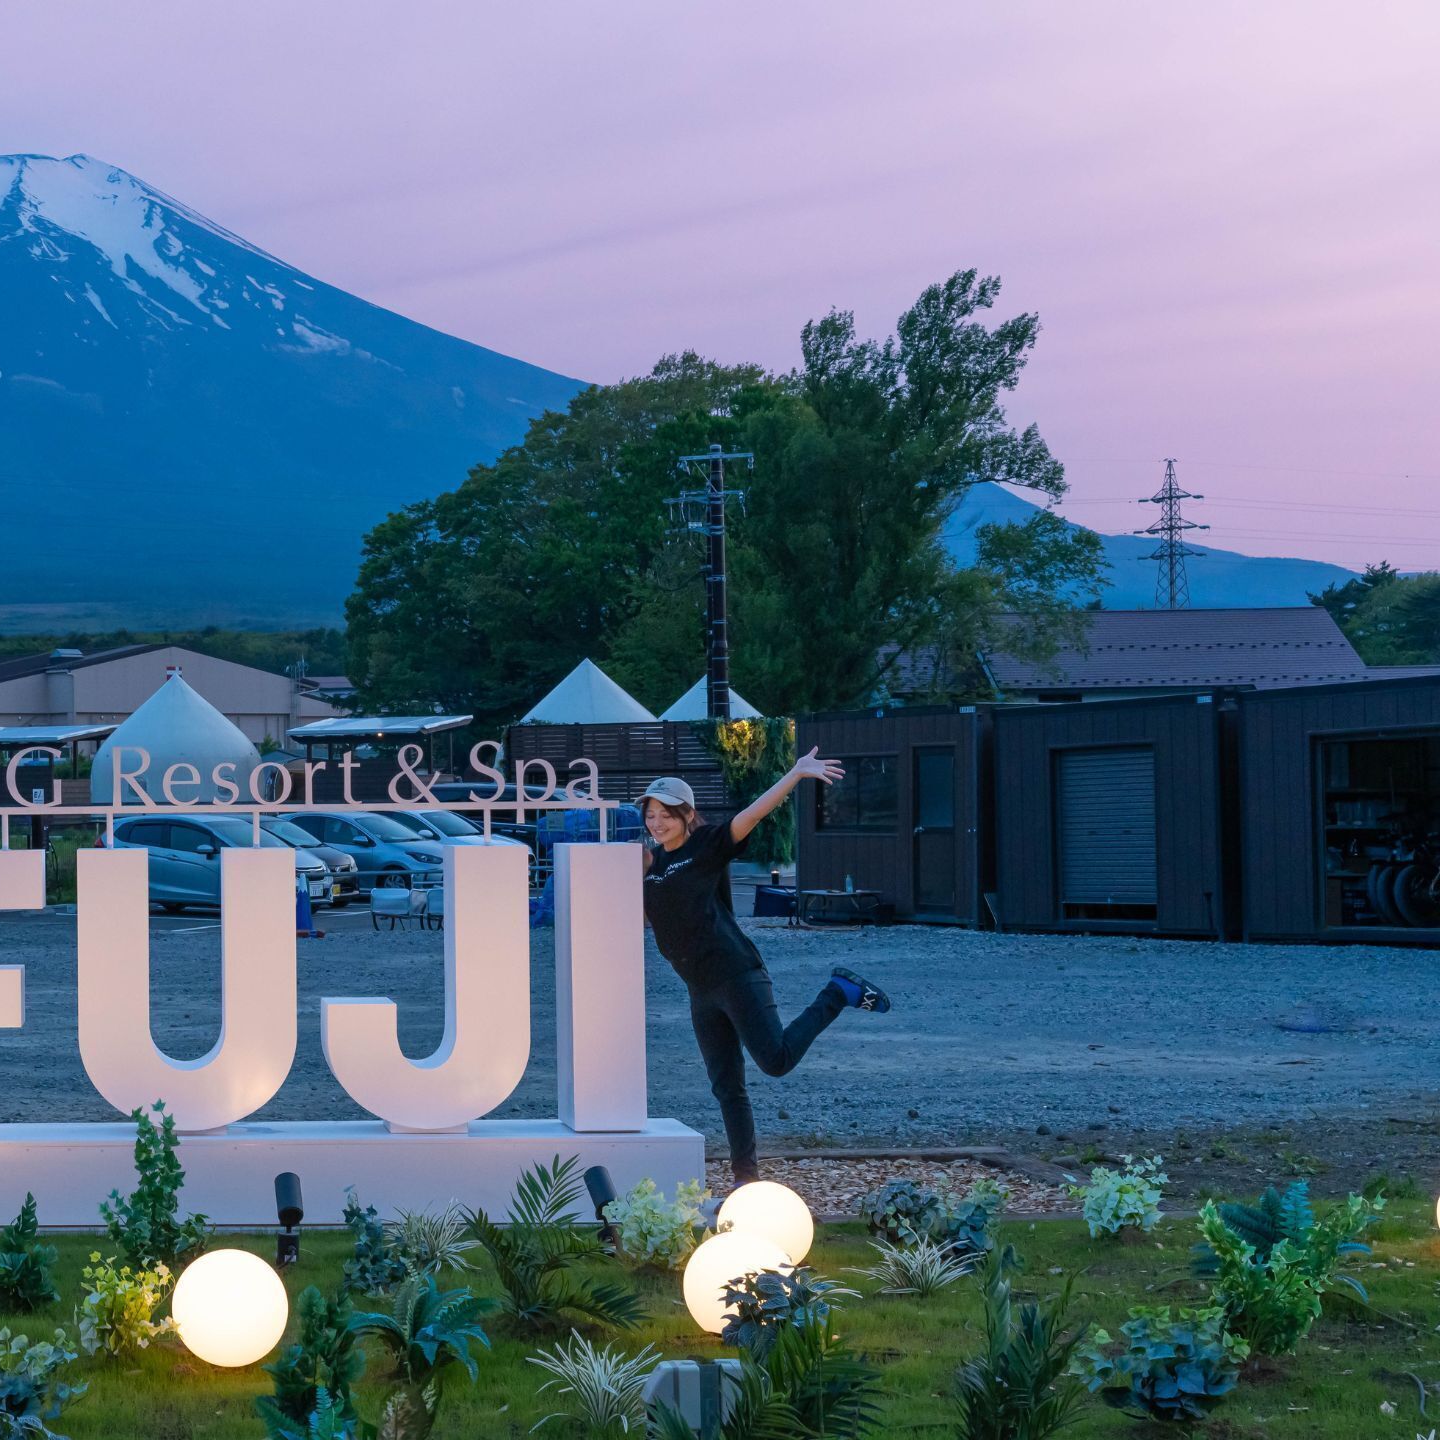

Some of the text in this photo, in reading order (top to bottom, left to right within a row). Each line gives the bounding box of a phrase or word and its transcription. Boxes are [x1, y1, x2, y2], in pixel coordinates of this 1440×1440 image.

[113, 747, 359, 806] Resort
[387, 744, 441, 804] &
[470, 740, 599, 823] Spa
